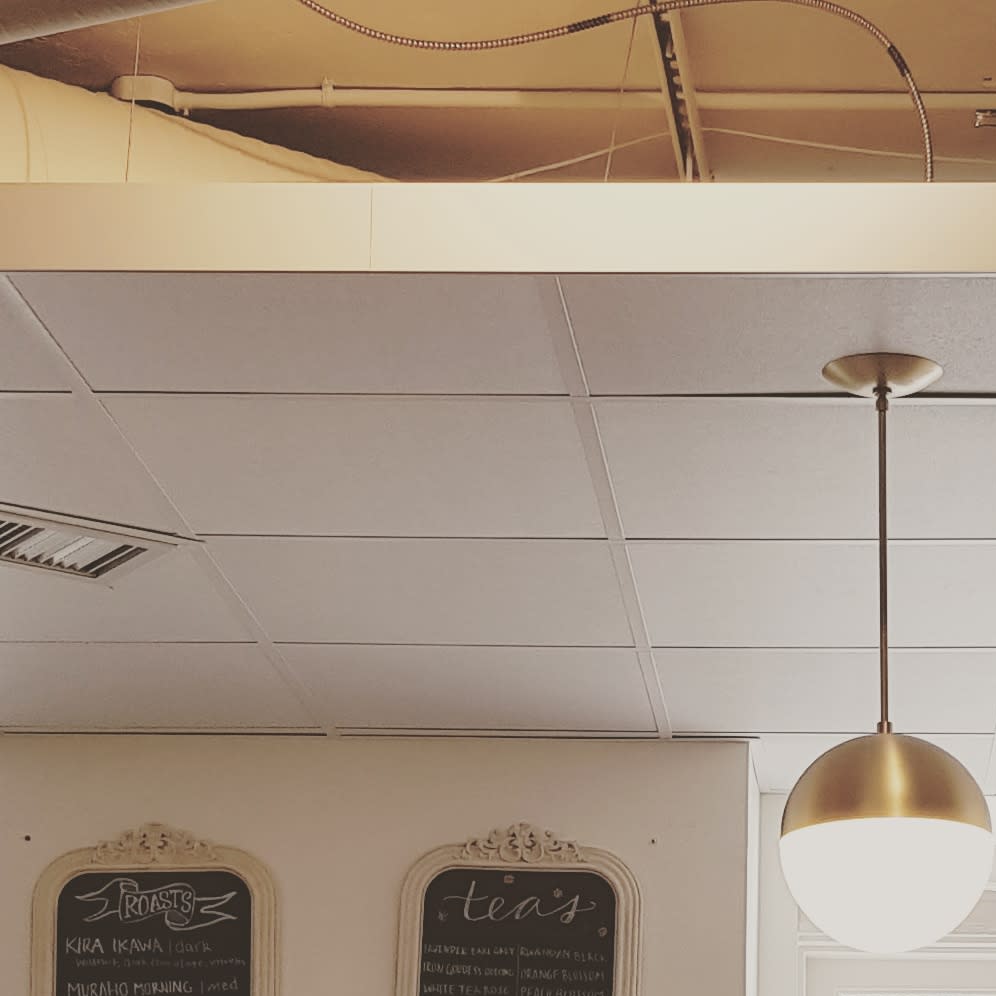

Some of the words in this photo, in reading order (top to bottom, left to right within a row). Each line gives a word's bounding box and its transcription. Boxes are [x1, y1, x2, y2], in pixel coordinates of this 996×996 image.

[124, 889, 192, 919] ROASTS
[443, 880, 597, 924] teas
[65, 937, 104, 954] KIRA
[112, 937, 163, 954] IKAWA
[175, 938, 214, 954] dark
[133, 980, 193, 996] MORNING
[208, 976, 239, 992] med
